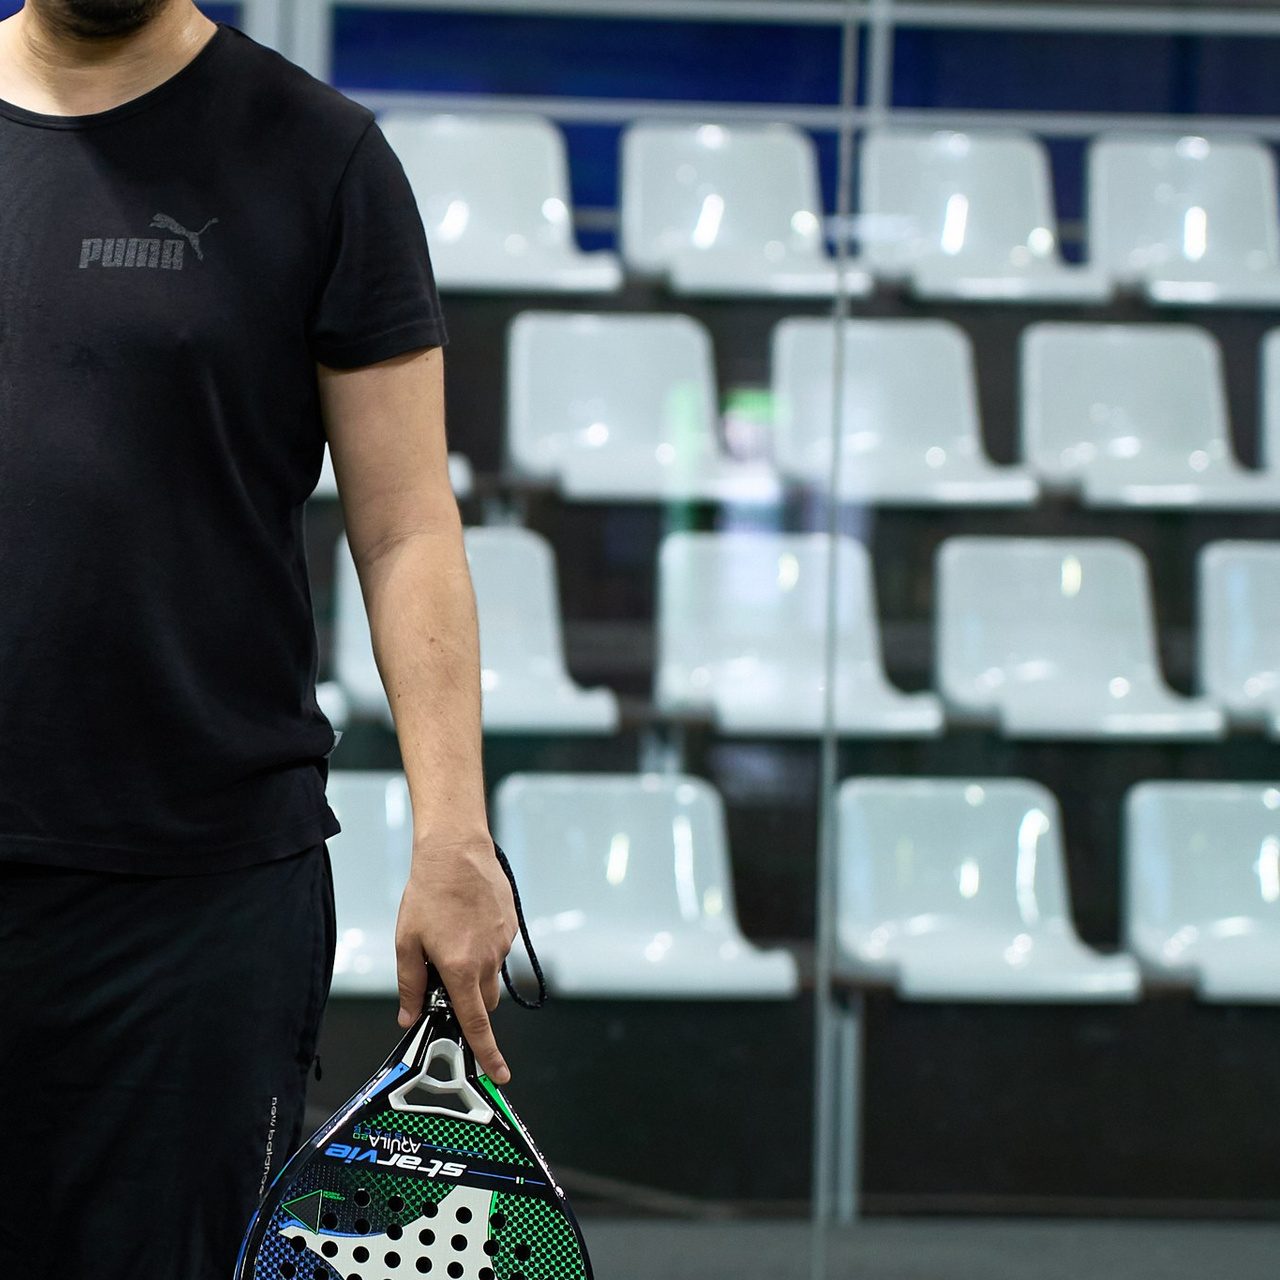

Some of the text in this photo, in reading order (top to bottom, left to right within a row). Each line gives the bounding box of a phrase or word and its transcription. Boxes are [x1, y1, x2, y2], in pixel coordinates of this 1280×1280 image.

[78, 237, 185, 271] PUMA
[258, 1097, 278, 1195] new balance
[324, 1142, 468, 1178] starvie
[368, 1134, 422, 1155] AQUILA
